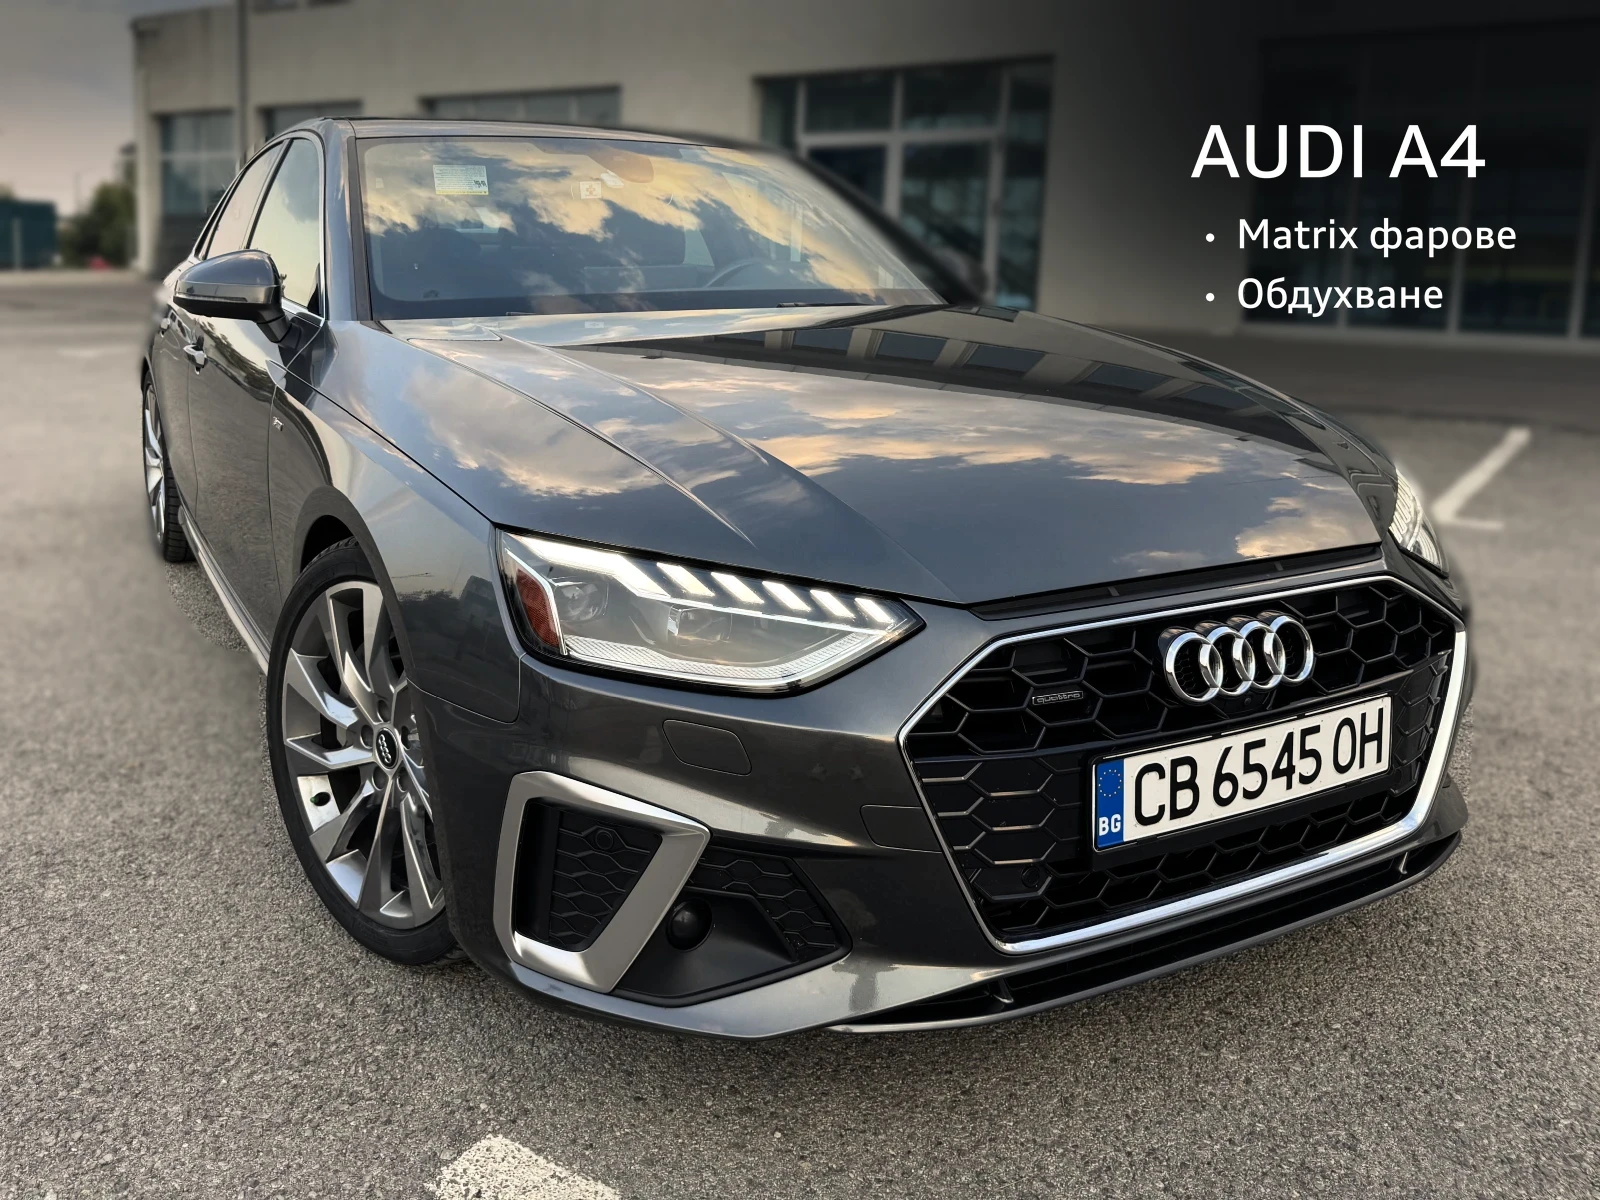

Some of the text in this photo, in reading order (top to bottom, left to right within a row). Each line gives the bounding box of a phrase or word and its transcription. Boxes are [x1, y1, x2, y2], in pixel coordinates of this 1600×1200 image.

[1036, 692, 1081, 704] quattro
[1133, 707, 1384, 827] CB 6545 OH
[1098, 813, 1122, 837] BG
